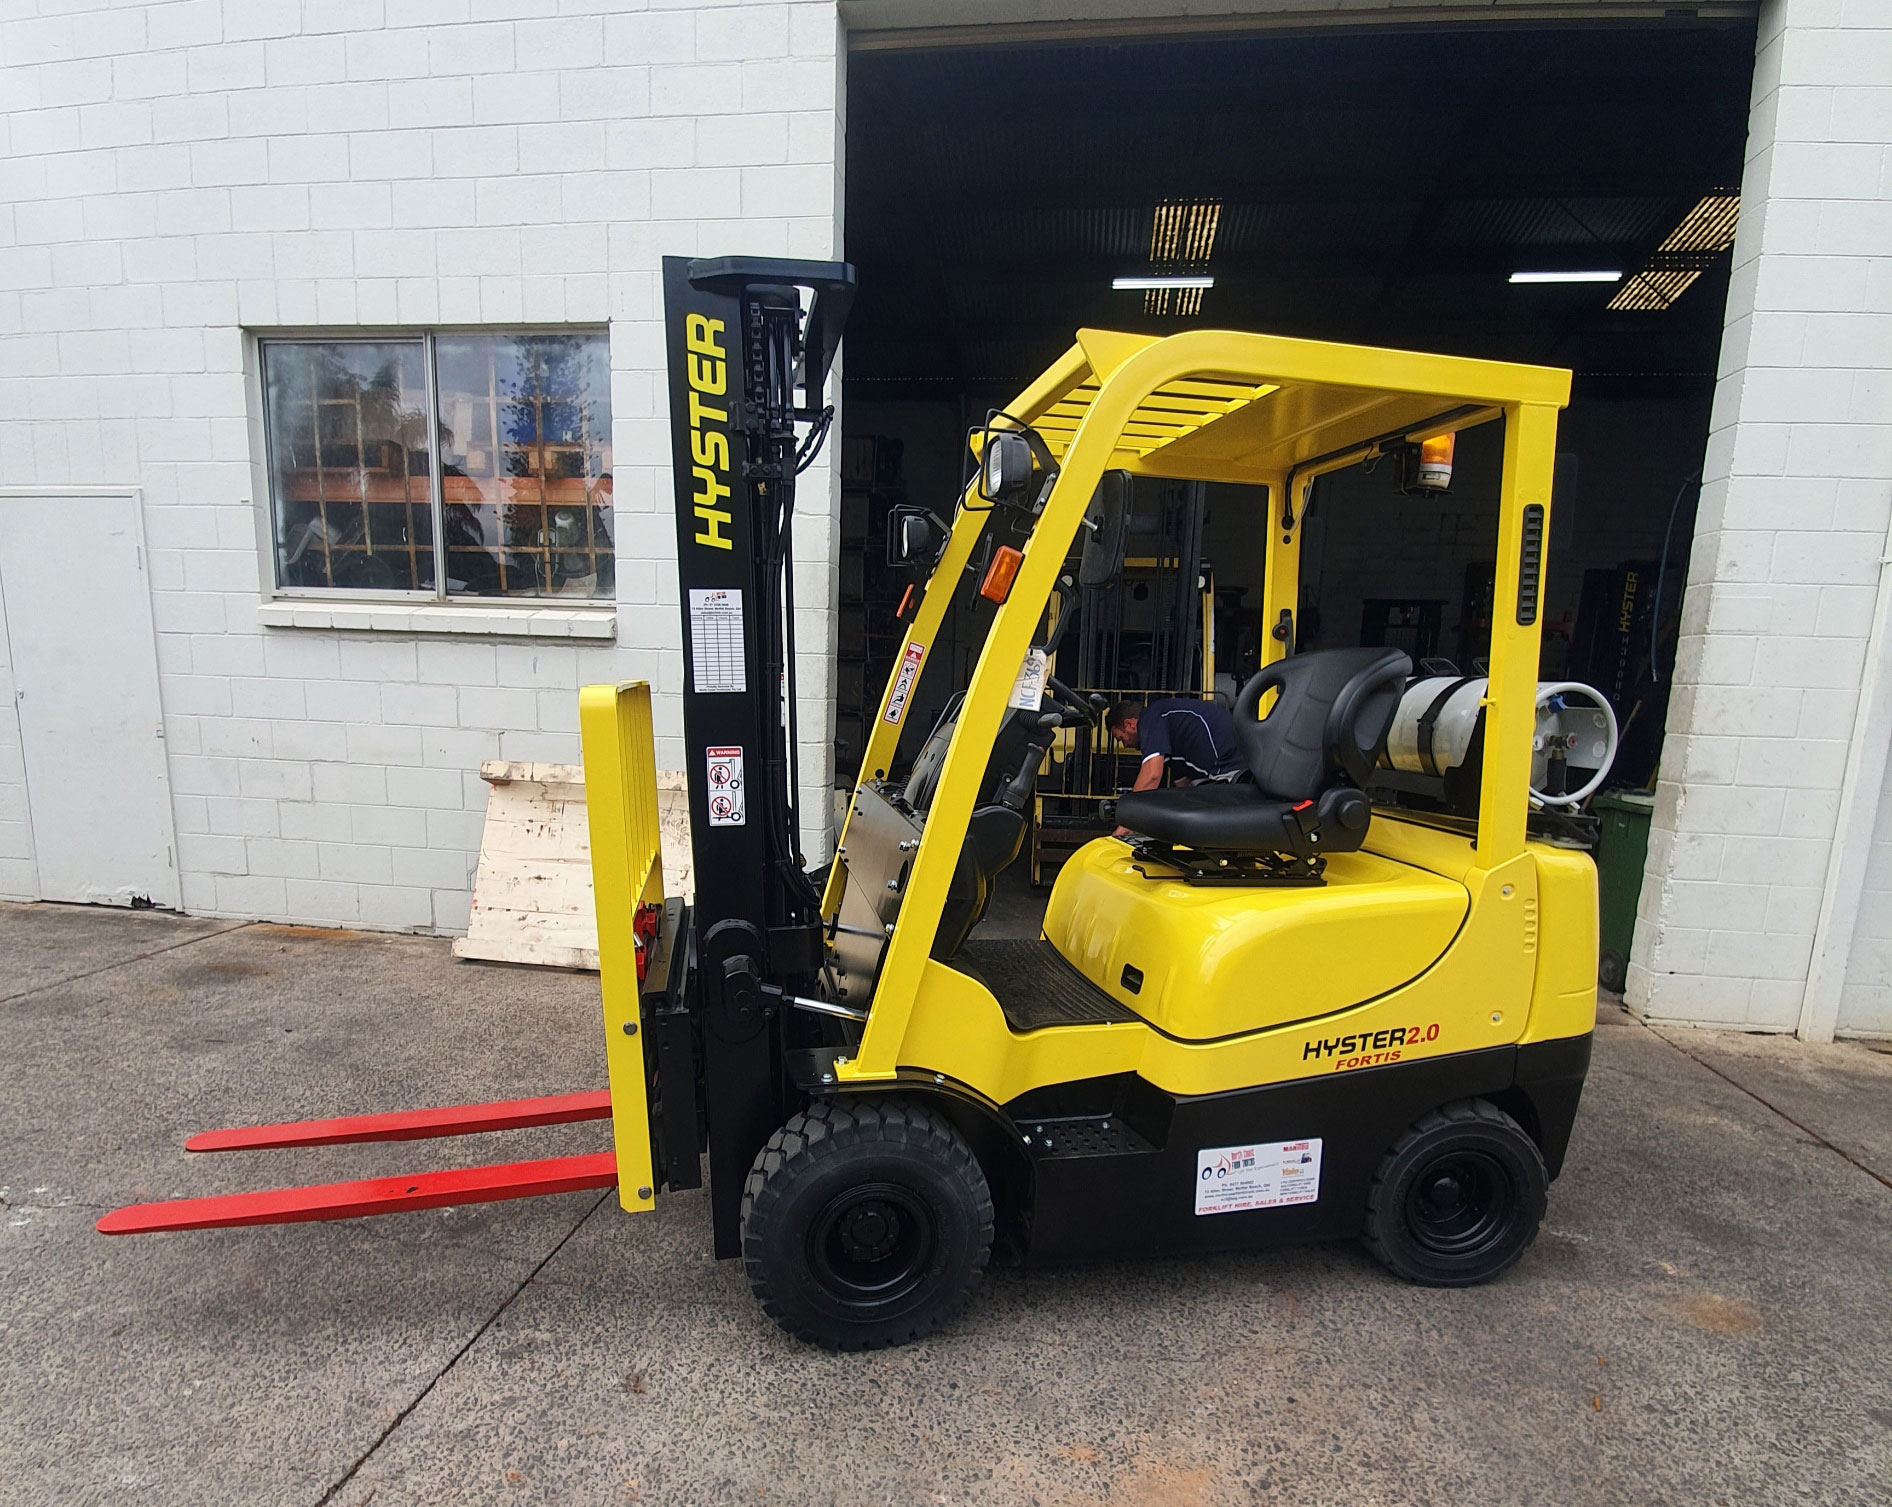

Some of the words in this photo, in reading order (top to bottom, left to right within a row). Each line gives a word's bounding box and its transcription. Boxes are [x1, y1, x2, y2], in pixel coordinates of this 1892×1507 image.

[686, 313, 732, 550] HYSTER
[1618, 571, 1639, 633] HYSTER
[1335, 1050, 1401, 1070] FORTIS
[1199, 1204, 1232, 1212] FORKLIFT
[1255, 1198, 1276, 1206] SALES
[1286, 1194, 1315, 1202] SERVICE
